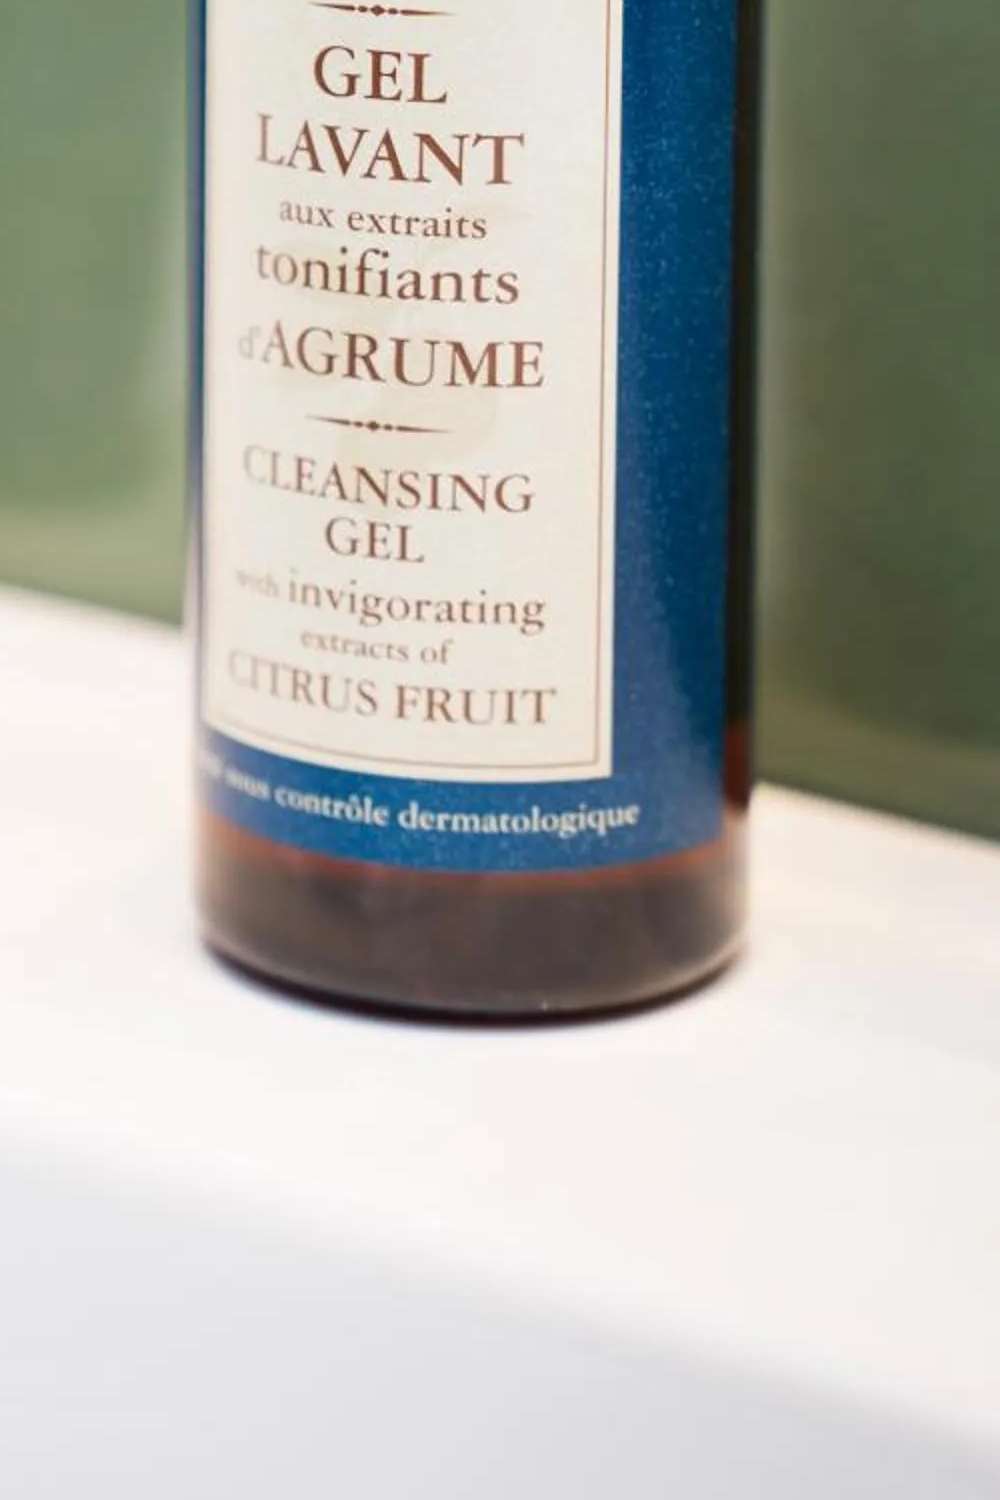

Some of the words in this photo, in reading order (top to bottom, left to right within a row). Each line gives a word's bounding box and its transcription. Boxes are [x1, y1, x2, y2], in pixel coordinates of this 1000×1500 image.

[313, 45, 448, 104] GEL
[255, 113, 525, 187] LAVANT
[279, 199, 335, 229] aux
[347, 206, 488, 239] extraits
[257, 244, 520, 305] tonifiants
[242, 444, 534, 514] CLEANSING
[324, 516, 426, 563] GEL
[288, 568, 547, 636] invigorating
[300, 630, 410, 663] extracts
[420, 639, 455, 666] of
[228, 648, 379, 718] CITRUS
[394, 683, 558, 727] FRUIT
[275, 784, 391, 828] contrôle
[397, 800, 641, 839] dermatologique
